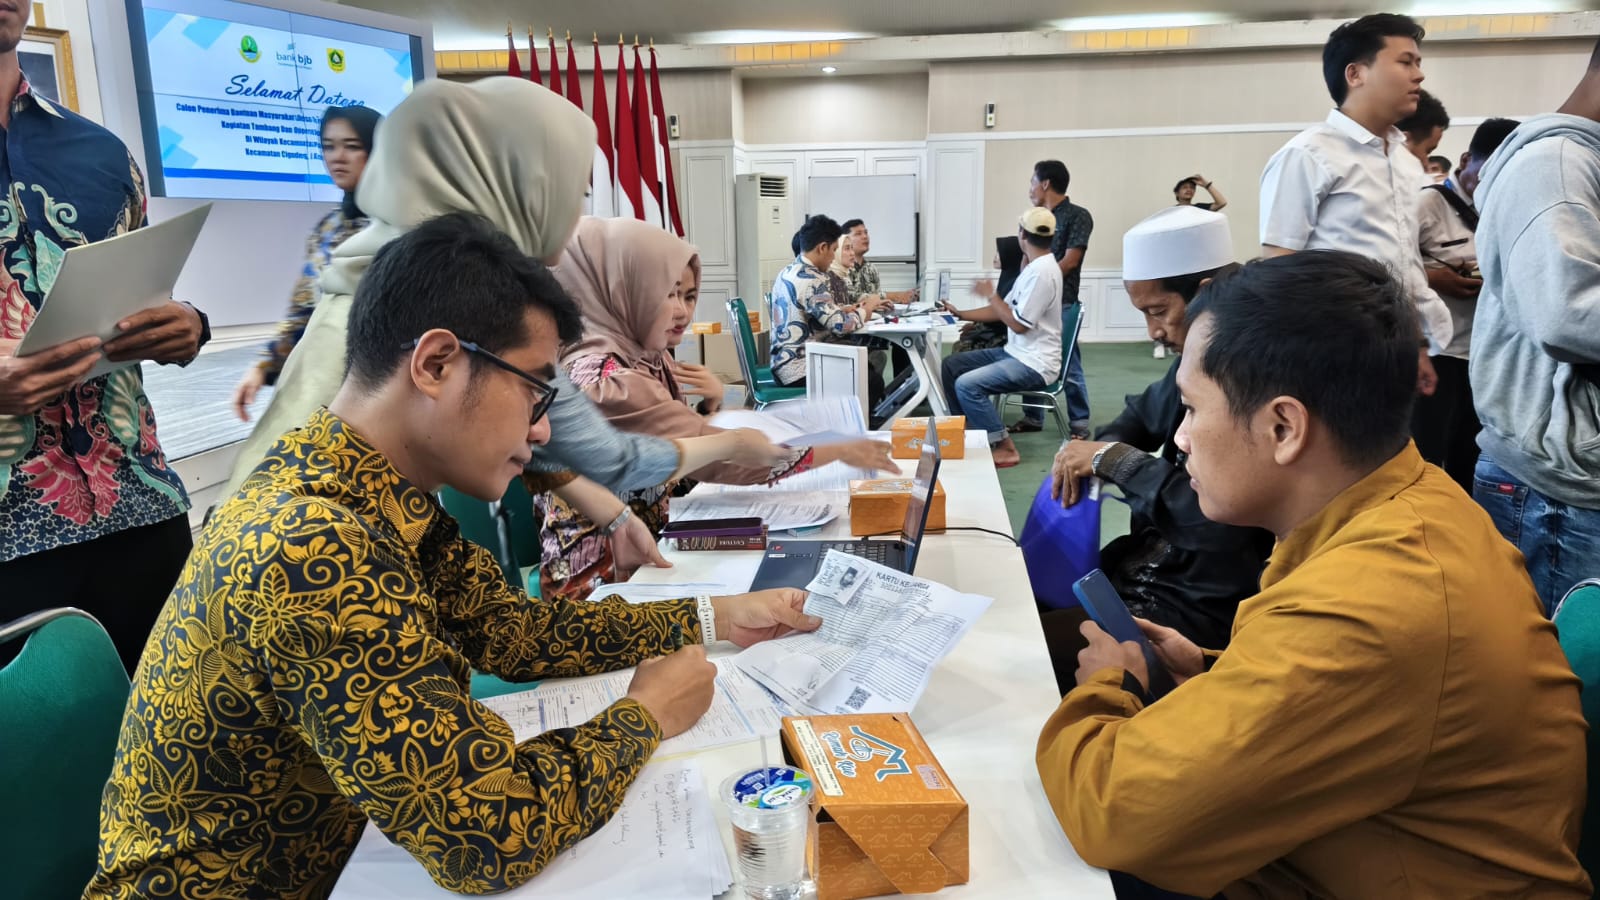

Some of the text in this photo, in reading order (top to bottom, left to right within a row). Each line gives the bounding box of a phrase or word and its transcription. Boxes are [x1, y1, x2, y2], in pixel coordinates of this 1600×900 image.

[276, 51, 296, 61] bank
[297, 54, 313, 65] bjb
[225, 74, 303, 101] Selamat
[176, 103, 196, 112] Calon
[197, 105, 230, 116] Penerima
[221, 120, 250, 129] Kegiatan
[251, 122, 280, 133] Tambang
[253, 135, 278, 145] Wilayah
[245, 148, 280, 157] Kecamatan
[876, 571, 899, 585] KARTU
